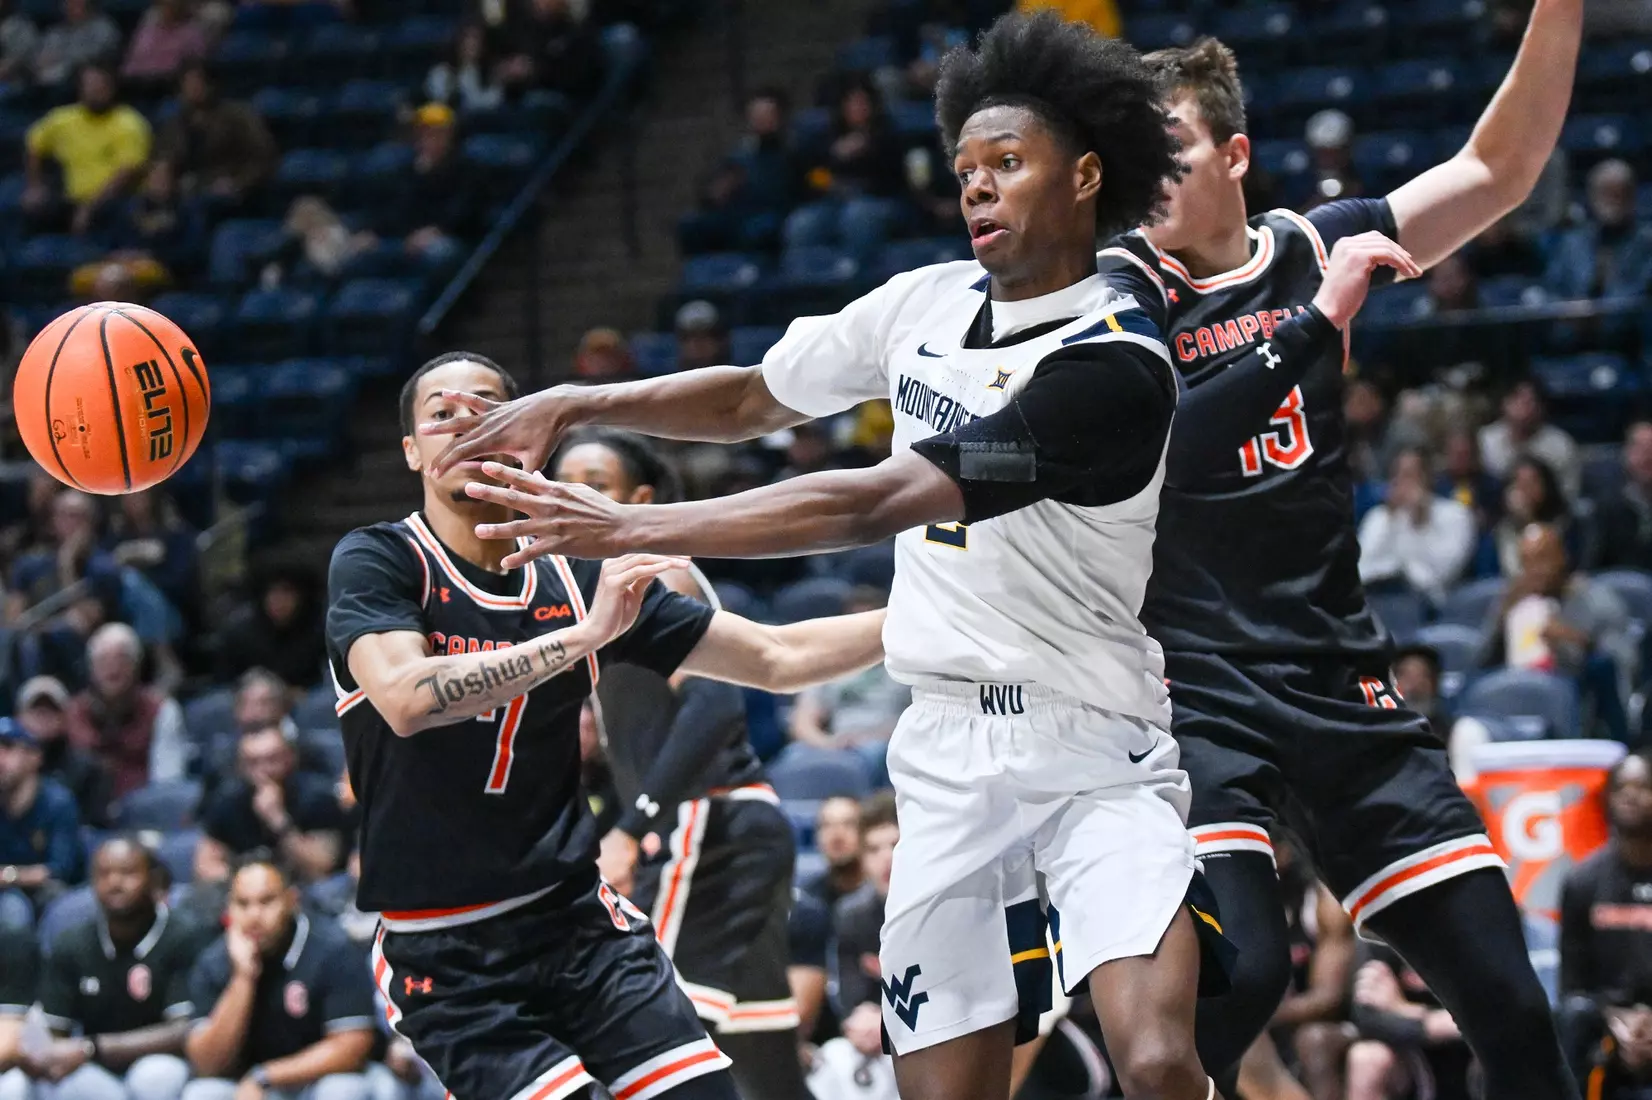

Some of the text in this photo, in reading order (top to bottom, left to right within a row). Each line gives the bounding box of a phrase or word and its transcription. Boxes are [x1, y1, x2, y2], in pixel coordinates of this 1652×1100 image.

[1175, 305, 1306, 363] CAMPBE
[133, 360, 174, 462] ELITE
[895, 374, 982, 434] MOUNTAIN
[533, 603, 572, 621] CAA
[415, 653, 534, 714] Joshua
[979, 684, 1025, 716] WVU
[1502, 790, 1562, 862] G
